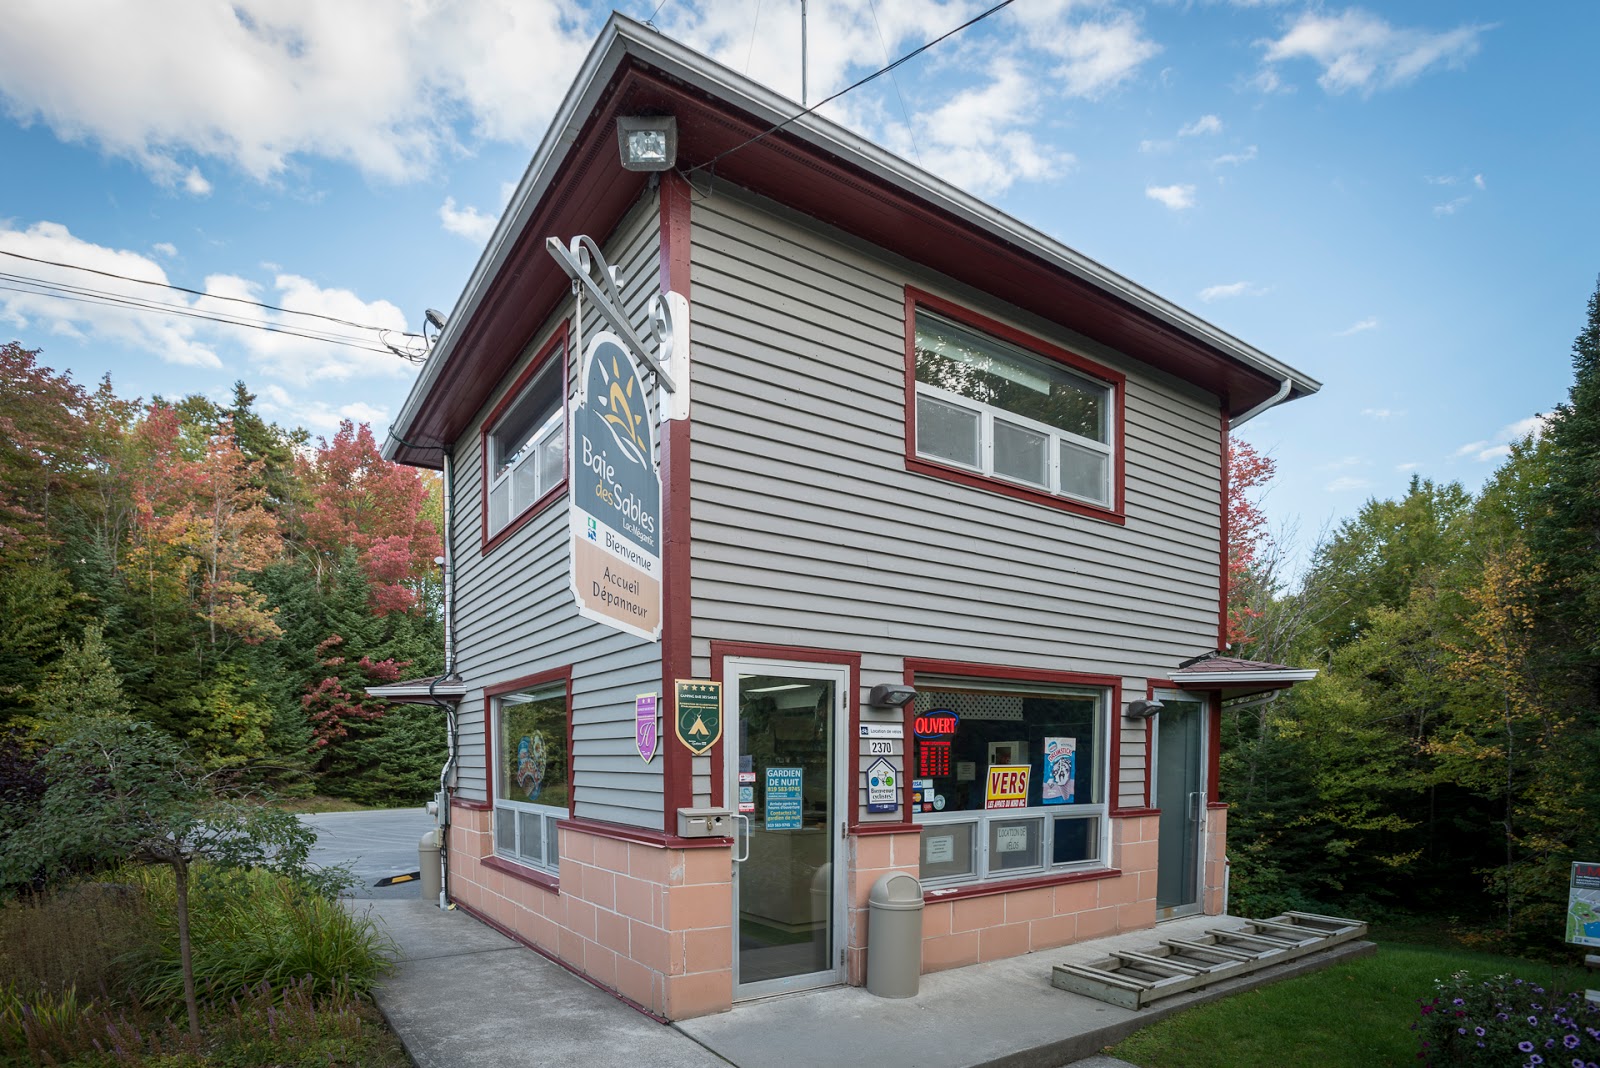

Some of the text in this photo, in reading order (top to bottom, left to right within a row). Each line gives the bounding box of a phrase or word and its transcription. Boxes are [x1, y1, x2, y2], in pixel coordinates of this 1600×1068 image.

[582, 434, 615, 485] Baie
[595, 479, 655, 534] des Sables
[605, 531, 652, 571] Bienvenue
[603, 566, 640, 596] Accueil
[592, 580, 648, 618] Dépanneur
[915, 717, 956, 734] OUVERT
[872, 742, 892, 753] 2370
[767, 769, 801, 777] GARDIEN
[769, 778, 800, 786] DE NUIT
[992, 771, 1026, 795] VERS
[998, 827, 1026, 837] LOCATION DE
